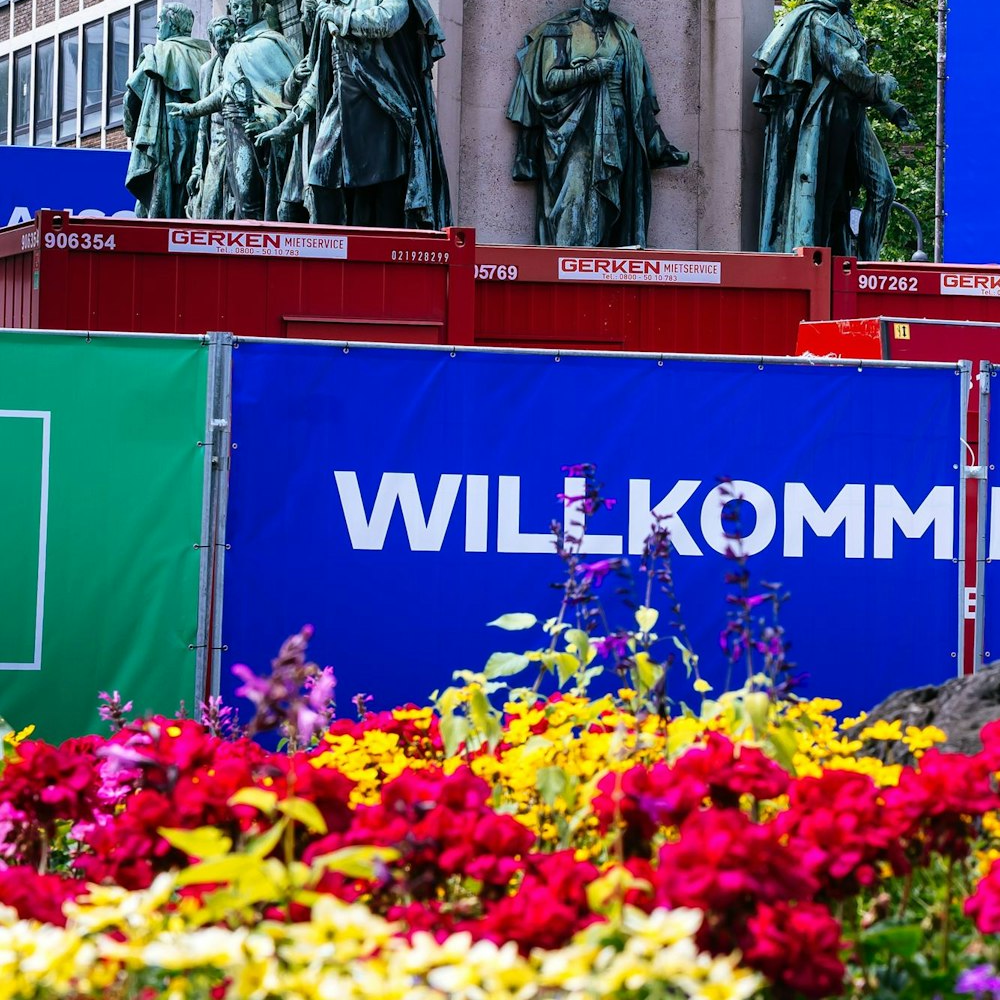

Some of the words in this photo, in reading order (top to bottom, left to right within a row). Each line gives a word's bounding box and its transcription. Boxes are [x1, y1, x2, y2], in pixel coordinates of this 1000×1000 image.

[44, 232, 116, 250] 906354
[171, 230, 281, 249] GERKEN
[284, 237, 344, 249] MIETSERVICE
[235, 247, 254, 255] 0800
[391, 250, 450, 263] 021928299
[561, 258, 661, 275] GERKEN
[664, 263, 717, 274] MIETSERVICE
[858, 274, 918, 292] 907262
